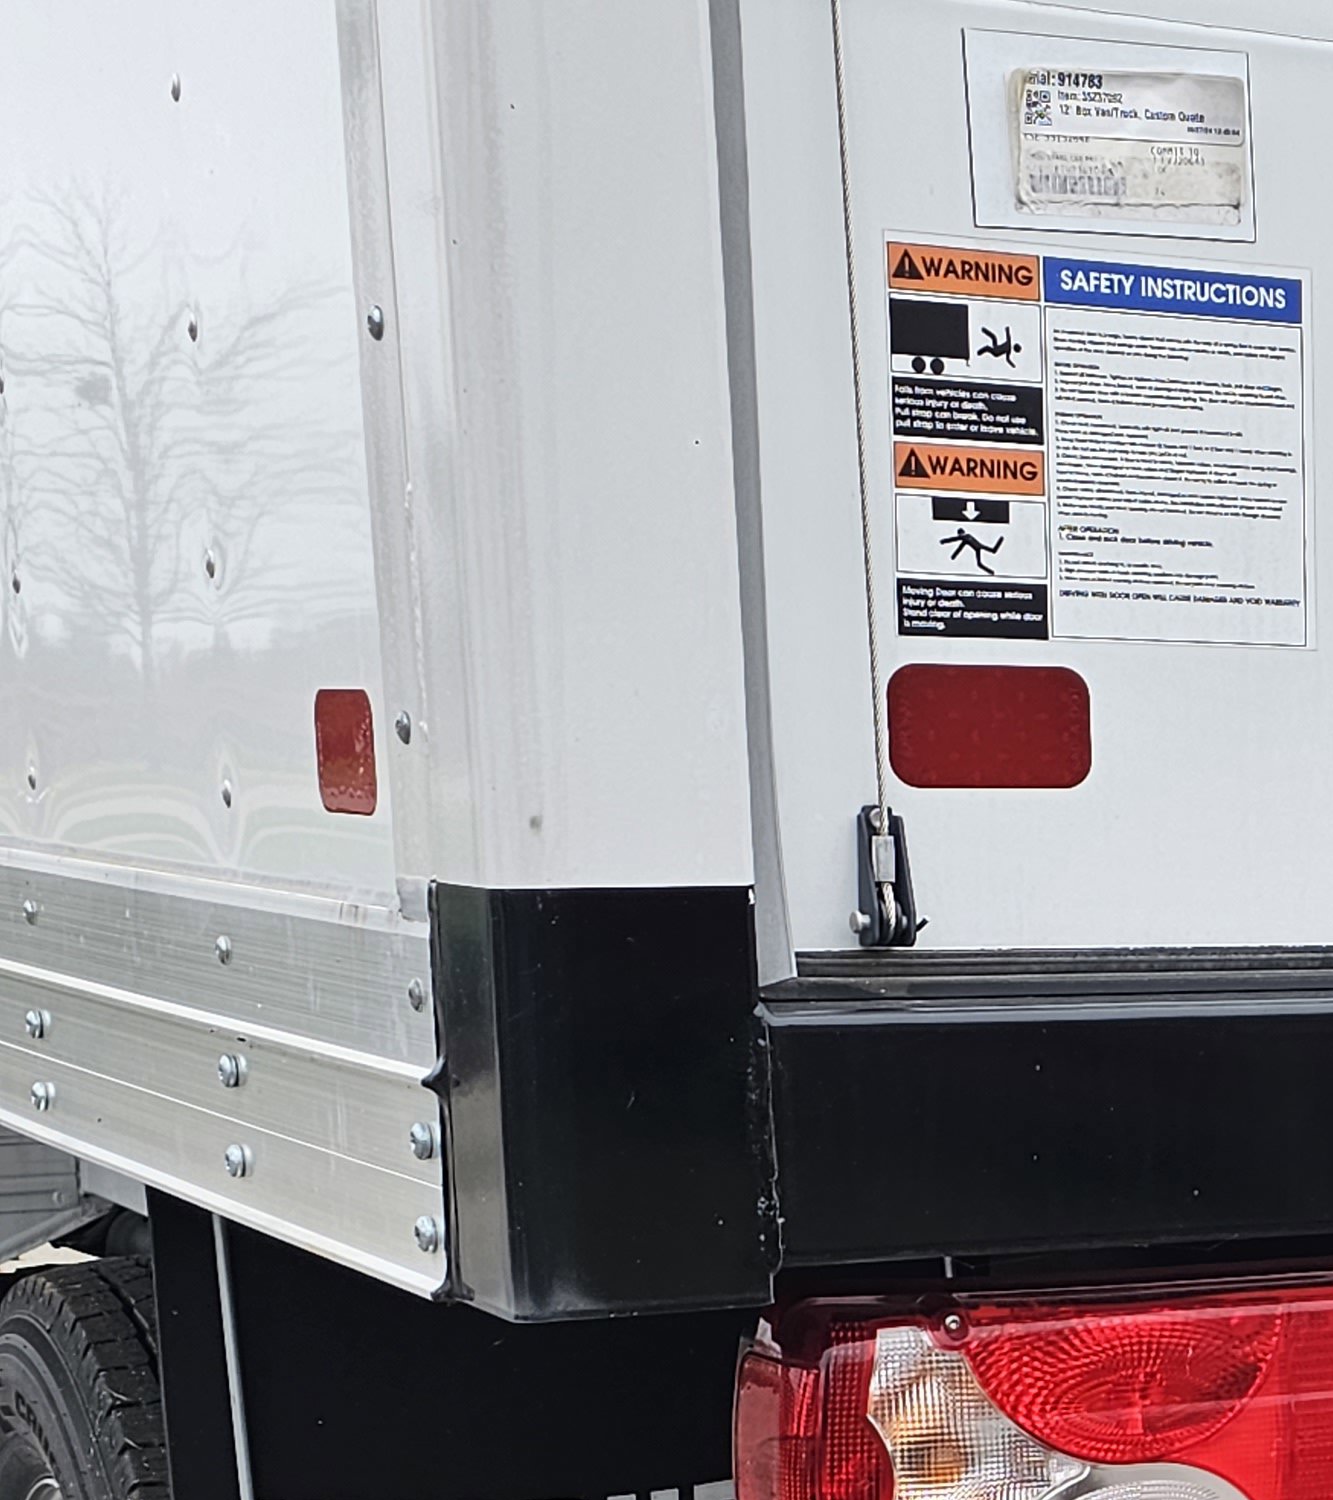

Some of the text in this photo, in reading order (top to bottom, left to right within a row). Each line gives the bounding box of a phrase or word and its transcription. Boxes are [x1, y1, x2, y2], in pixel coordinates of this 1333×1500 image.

[921, 255, 1034, 287] WARNING
[1060, 267, 1287, 310] SAFETY INSTRUCTIONS
[927, 454, 1038, 482] WARNING
